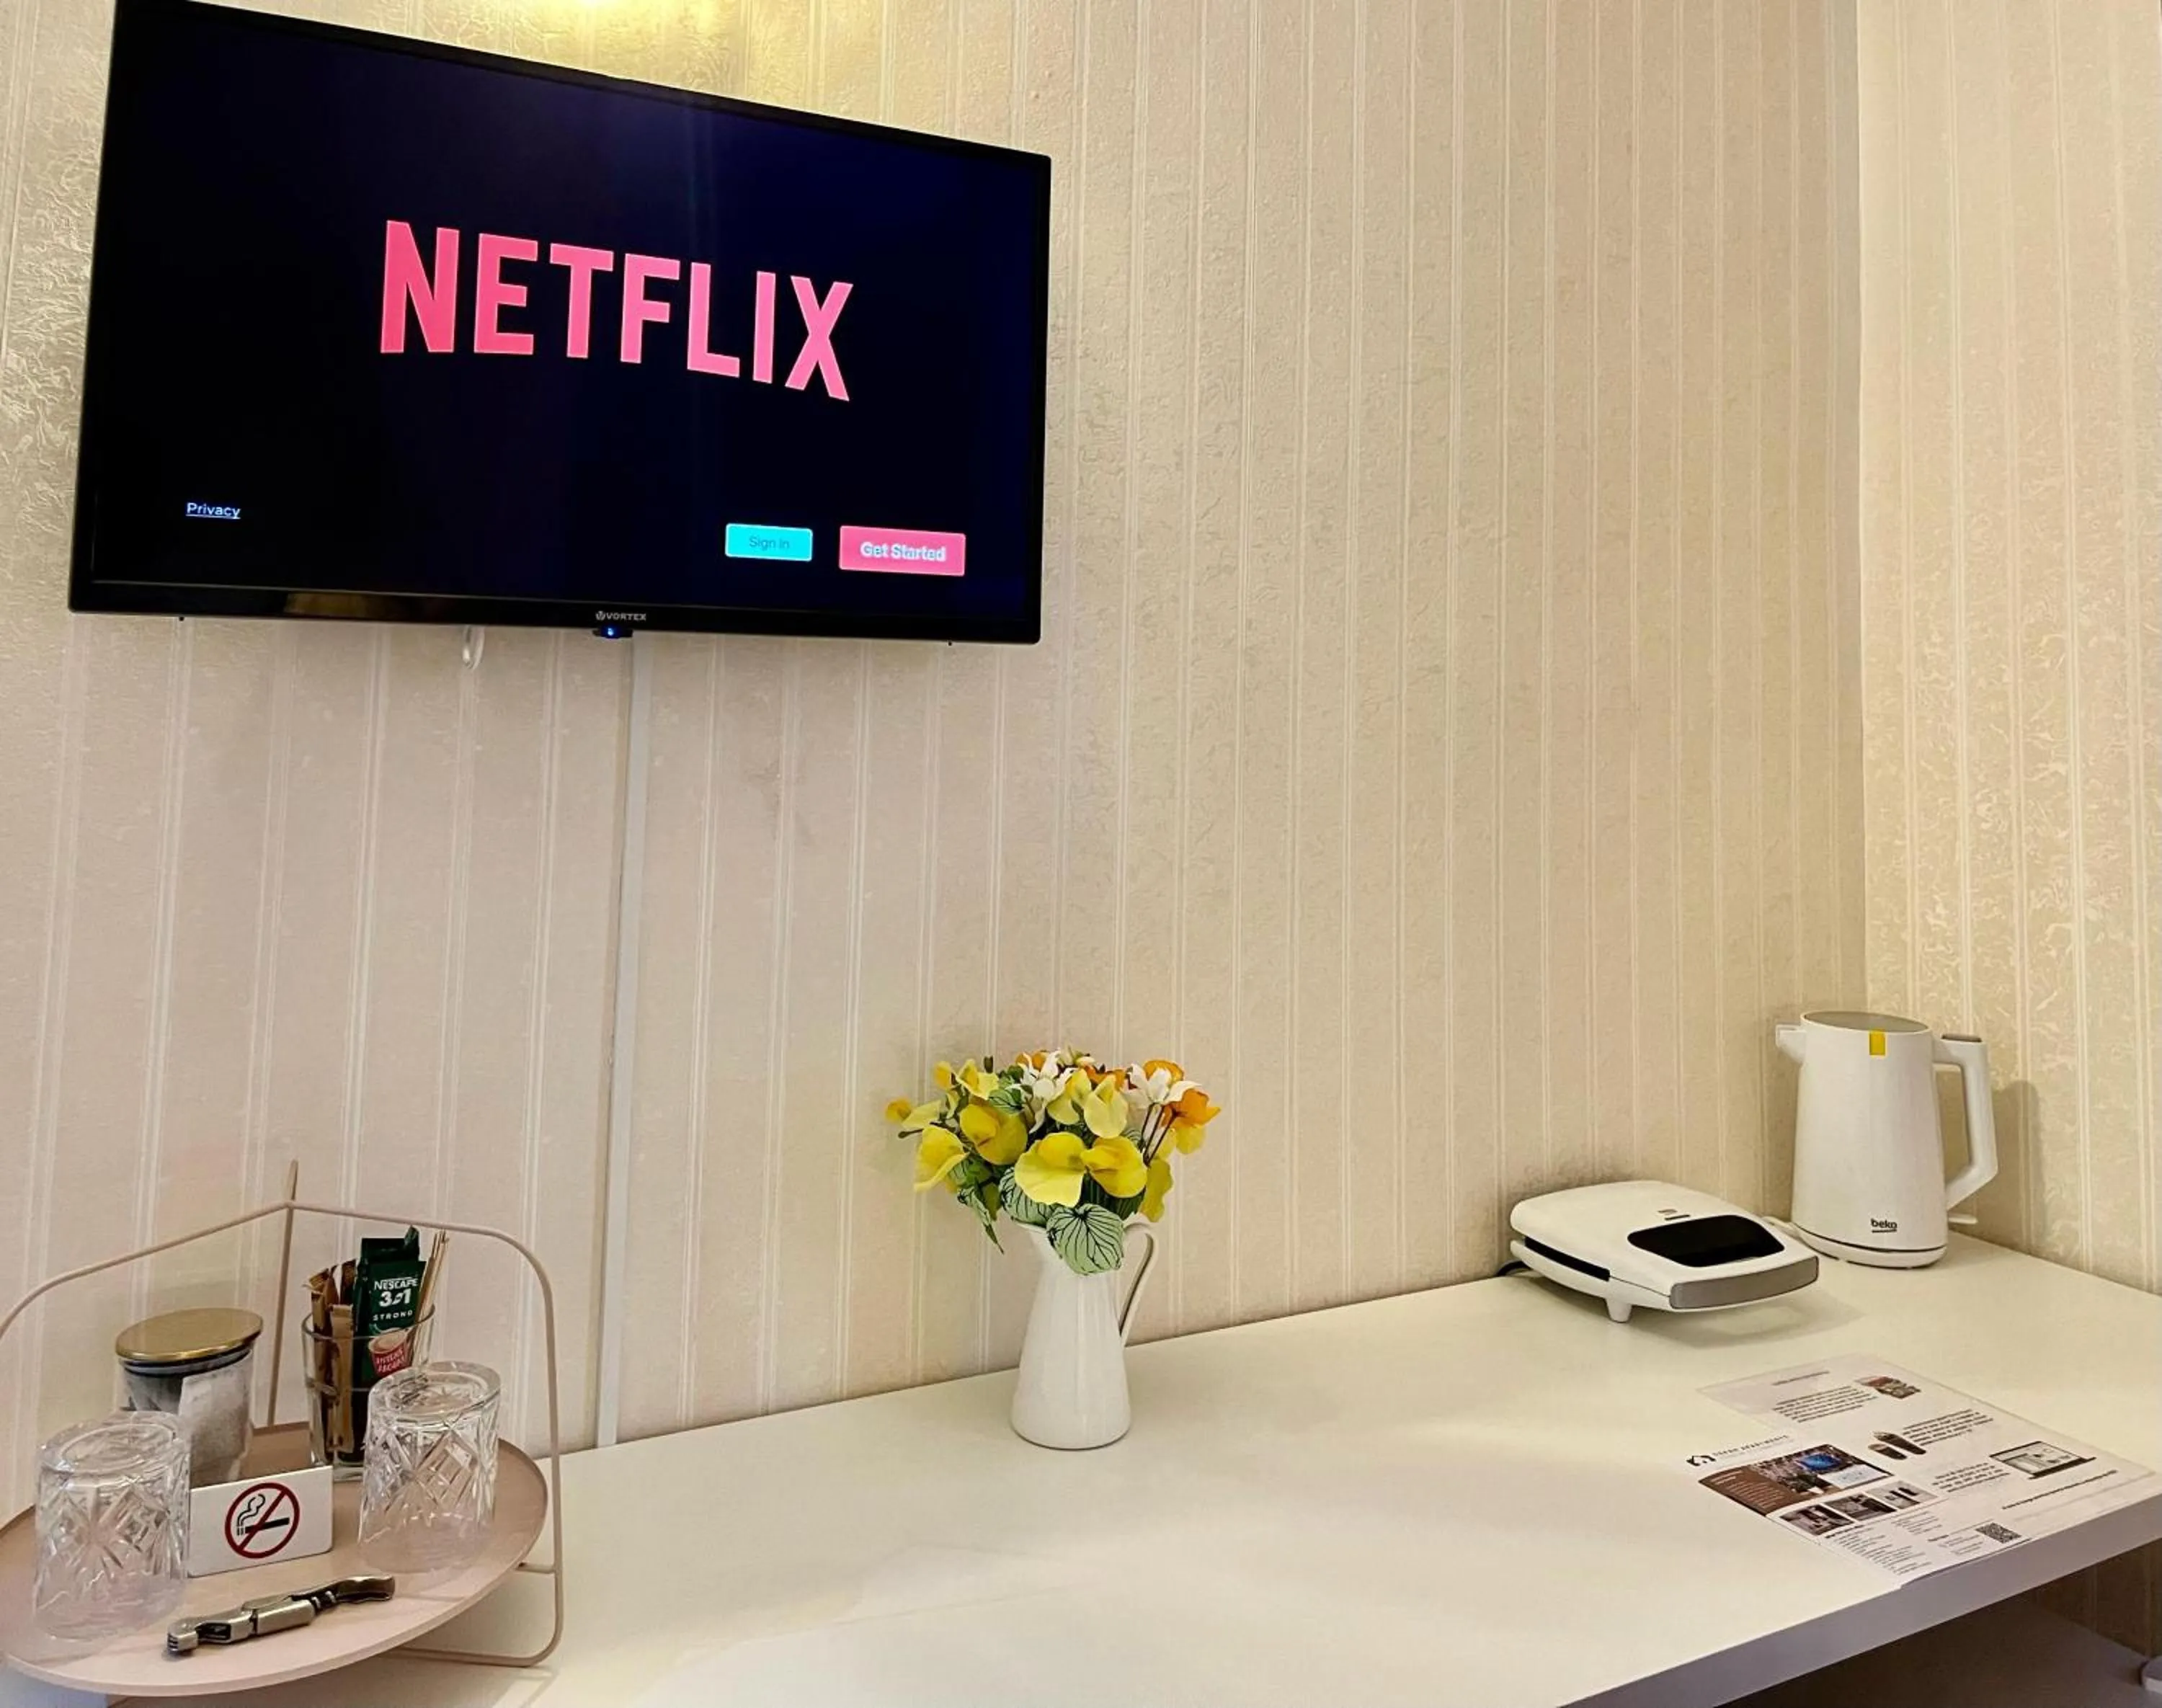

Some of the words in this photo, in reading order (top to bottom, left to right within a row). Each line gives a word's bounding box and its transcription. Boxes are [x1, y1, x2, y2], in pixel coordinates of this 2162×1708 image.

[381, 220, 854, 401] NETFLIX
[186, 502, 241, 520] Privacy
[749, 535, 776, 551] Sign
[860, 541, 889, 558] Get
[891, 543, 946, 562] Started
[606, 612, 646, 621] VORTEX
[1870, 1218, 1898, 1229] beko
